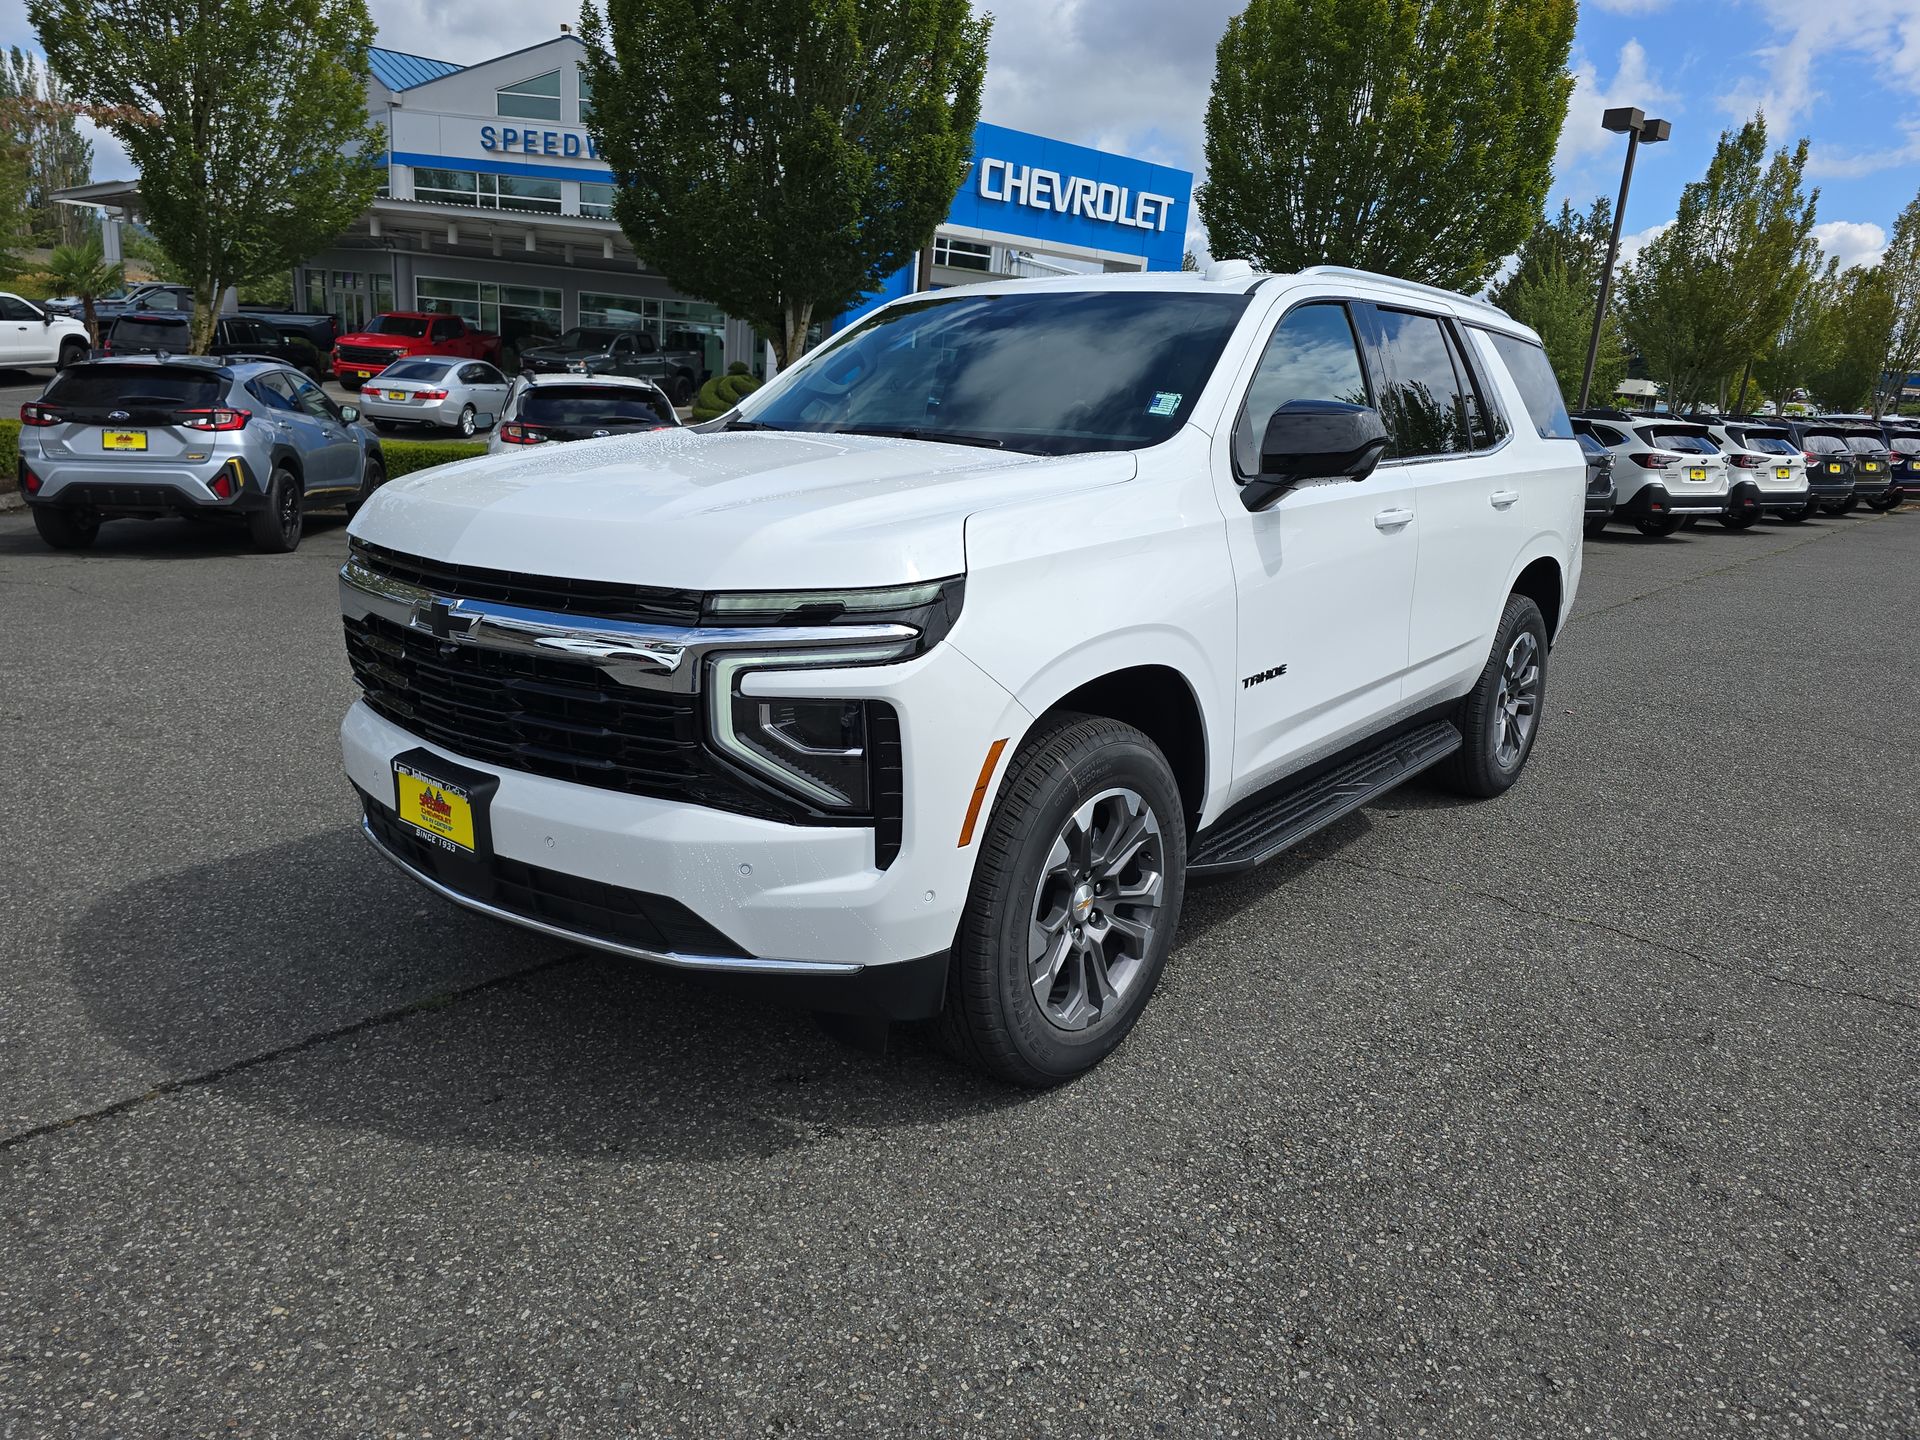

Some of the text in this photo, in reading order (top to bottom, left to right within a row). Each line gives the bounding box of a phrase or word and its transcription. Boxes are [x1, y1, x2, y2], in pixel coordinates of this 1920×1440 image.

[980, 157, 1175, 232] CHEVROLET
[1241, 663, 1288, 690] TAHOE
[415, 828, 436, 844] SINCE
[438, 838, 456, 853] 1933
